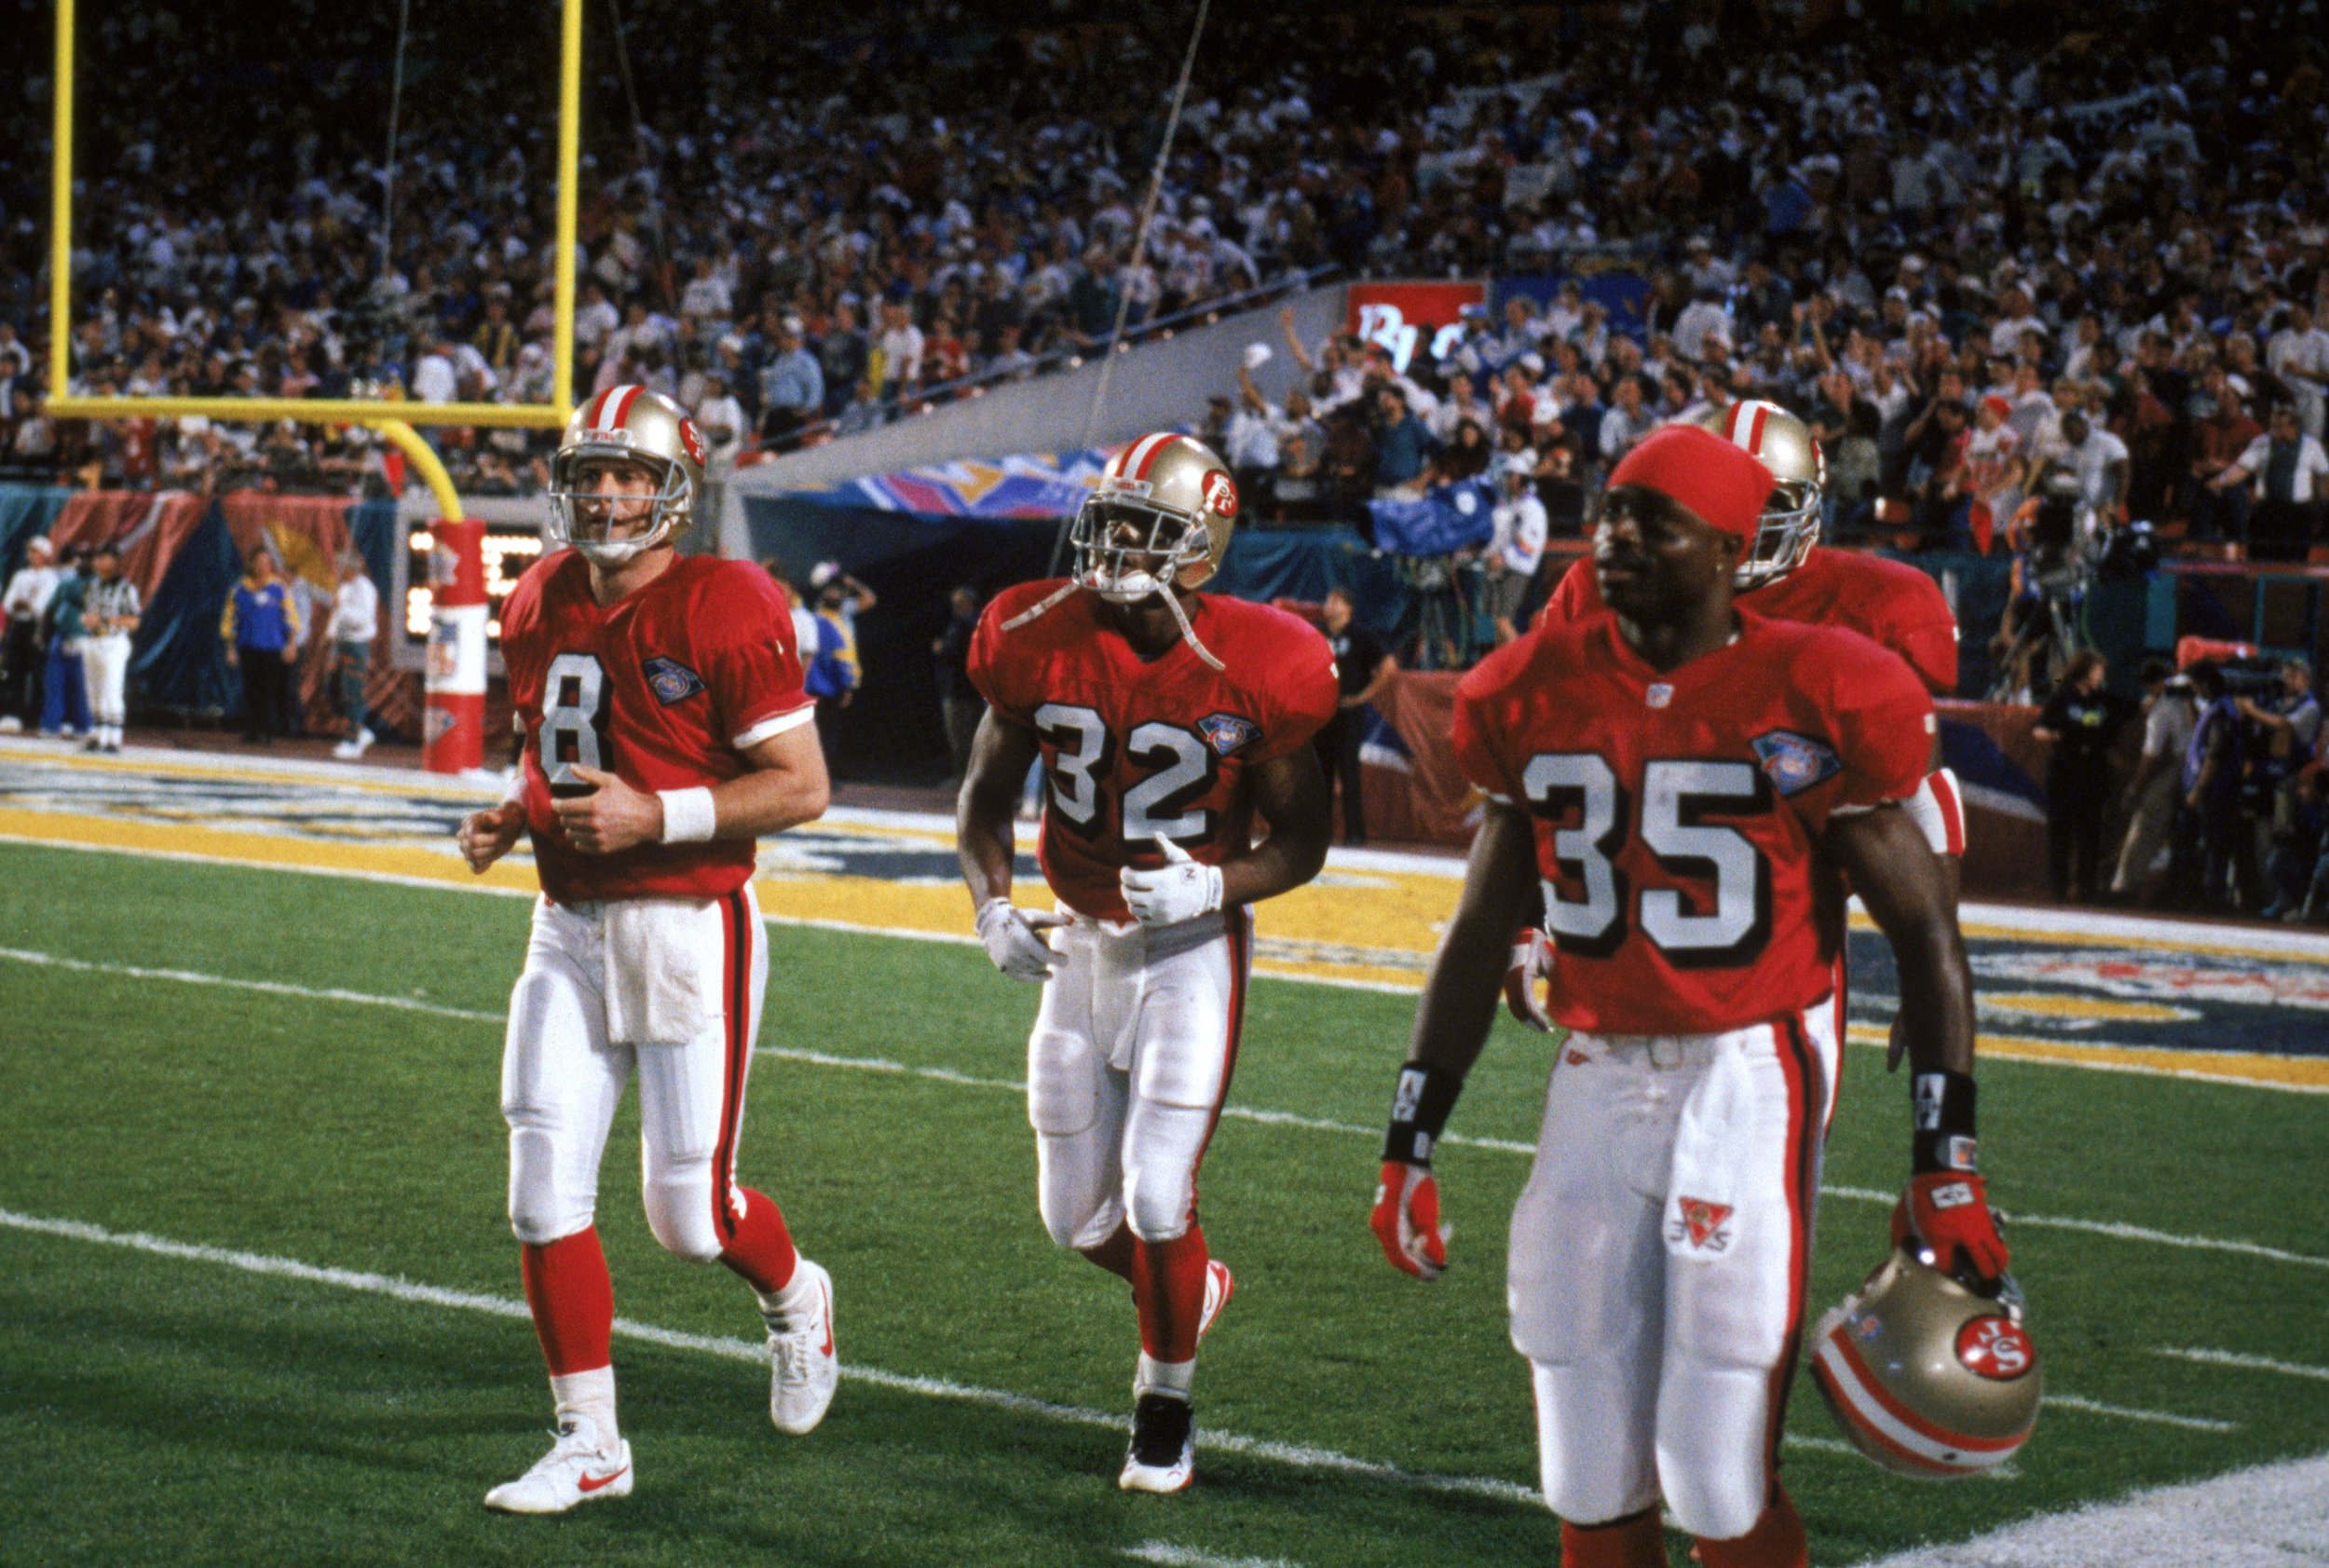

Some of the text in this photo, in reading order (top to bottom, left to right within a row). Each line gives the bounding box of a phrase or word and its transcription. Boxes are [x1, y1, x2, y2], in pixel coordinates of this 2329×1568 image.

[540, 652, 607, 788] 8
[1033, 702, 1209, 841] 32
[1522, 753, 1761, 953] 35
